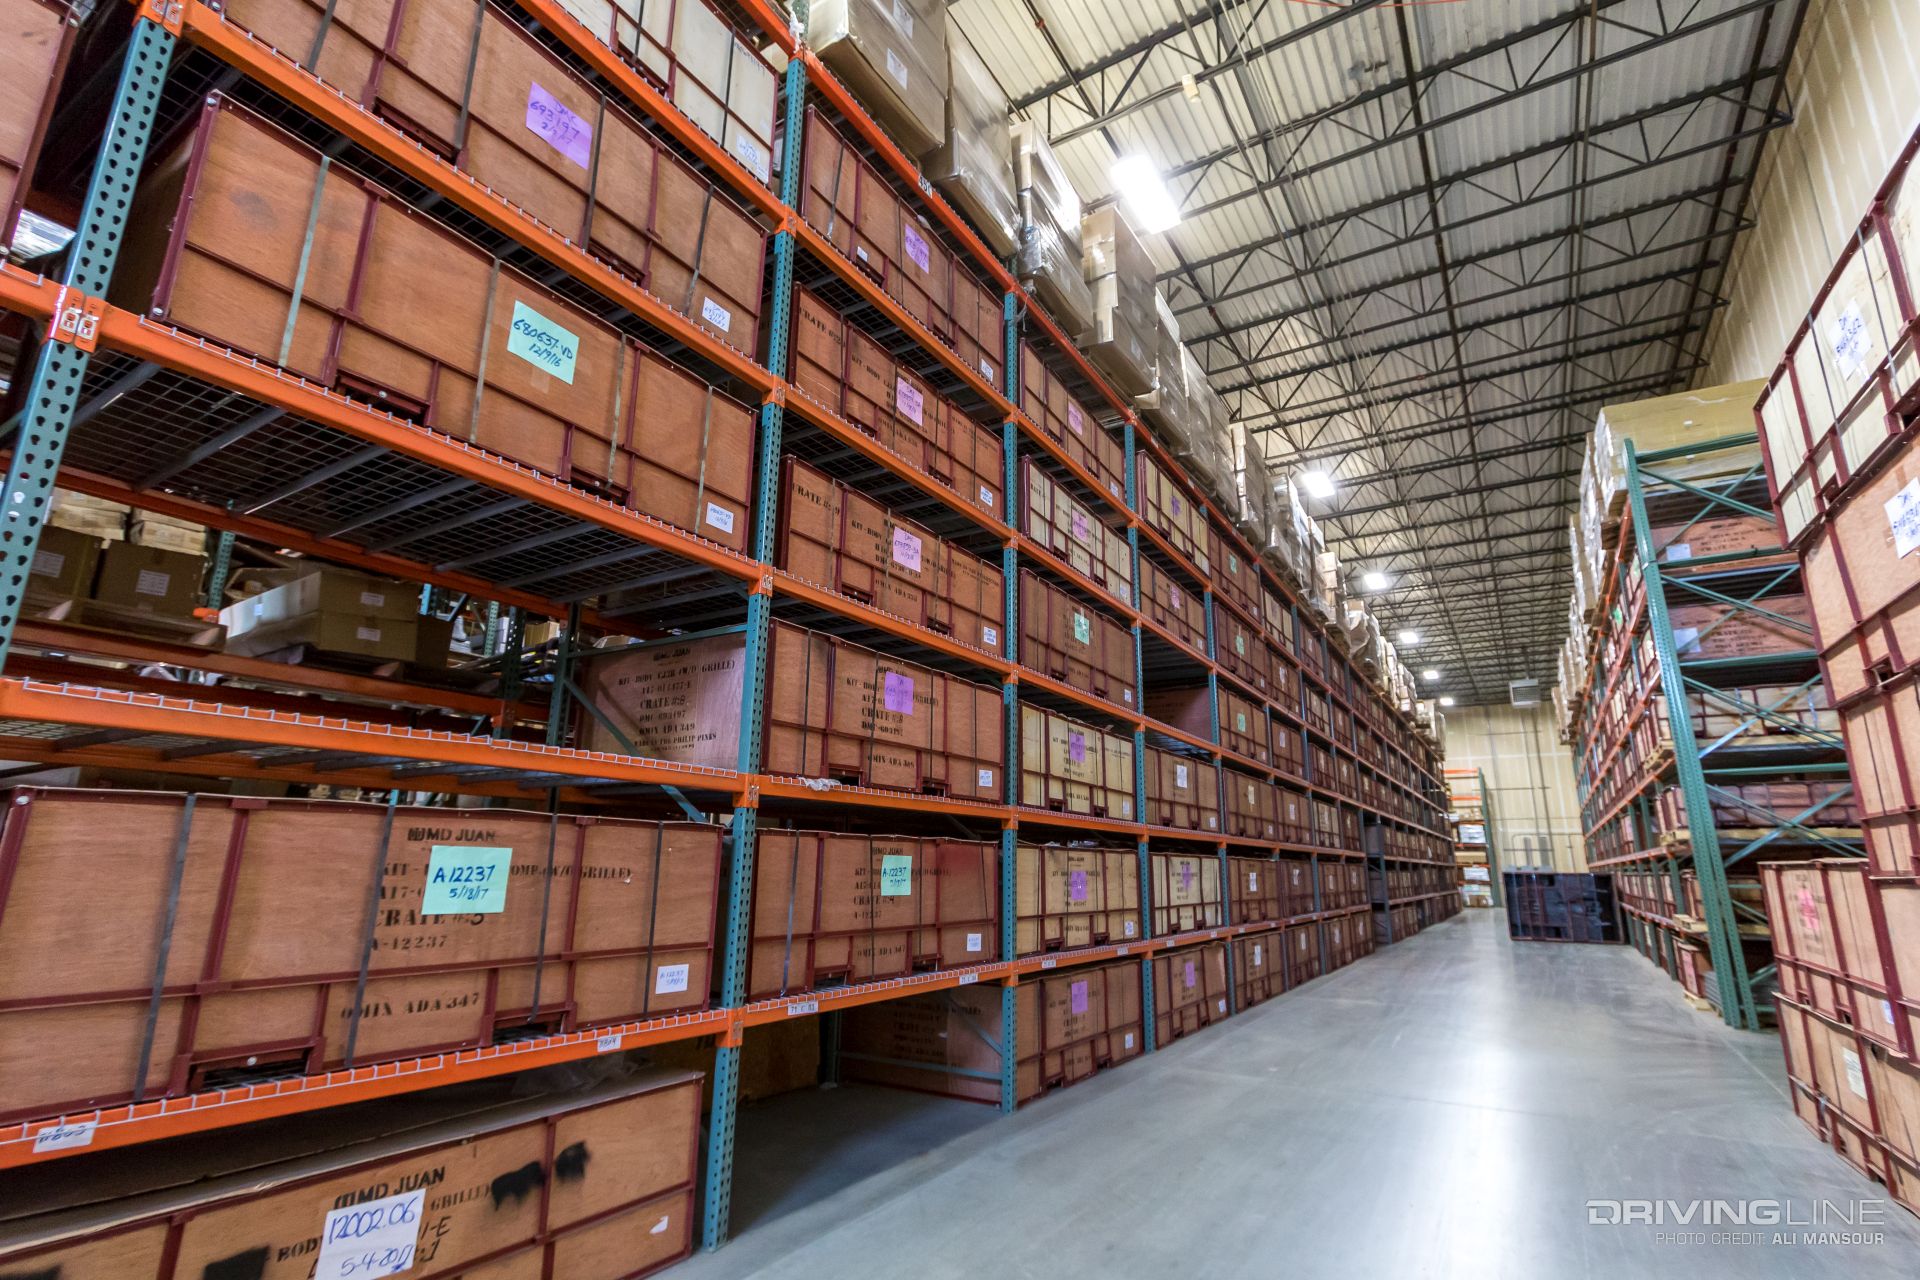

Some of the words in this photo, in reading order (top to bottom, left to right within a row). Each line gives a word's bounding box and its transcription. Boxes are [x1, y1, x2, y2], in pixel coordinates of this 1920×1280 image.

[529, 101, 580, 139] 693197
[455, 829, 496, 842] JUAN
[405, 999, 441, 1014] ADA
[393, 1166, 446, 1194] JUAN
